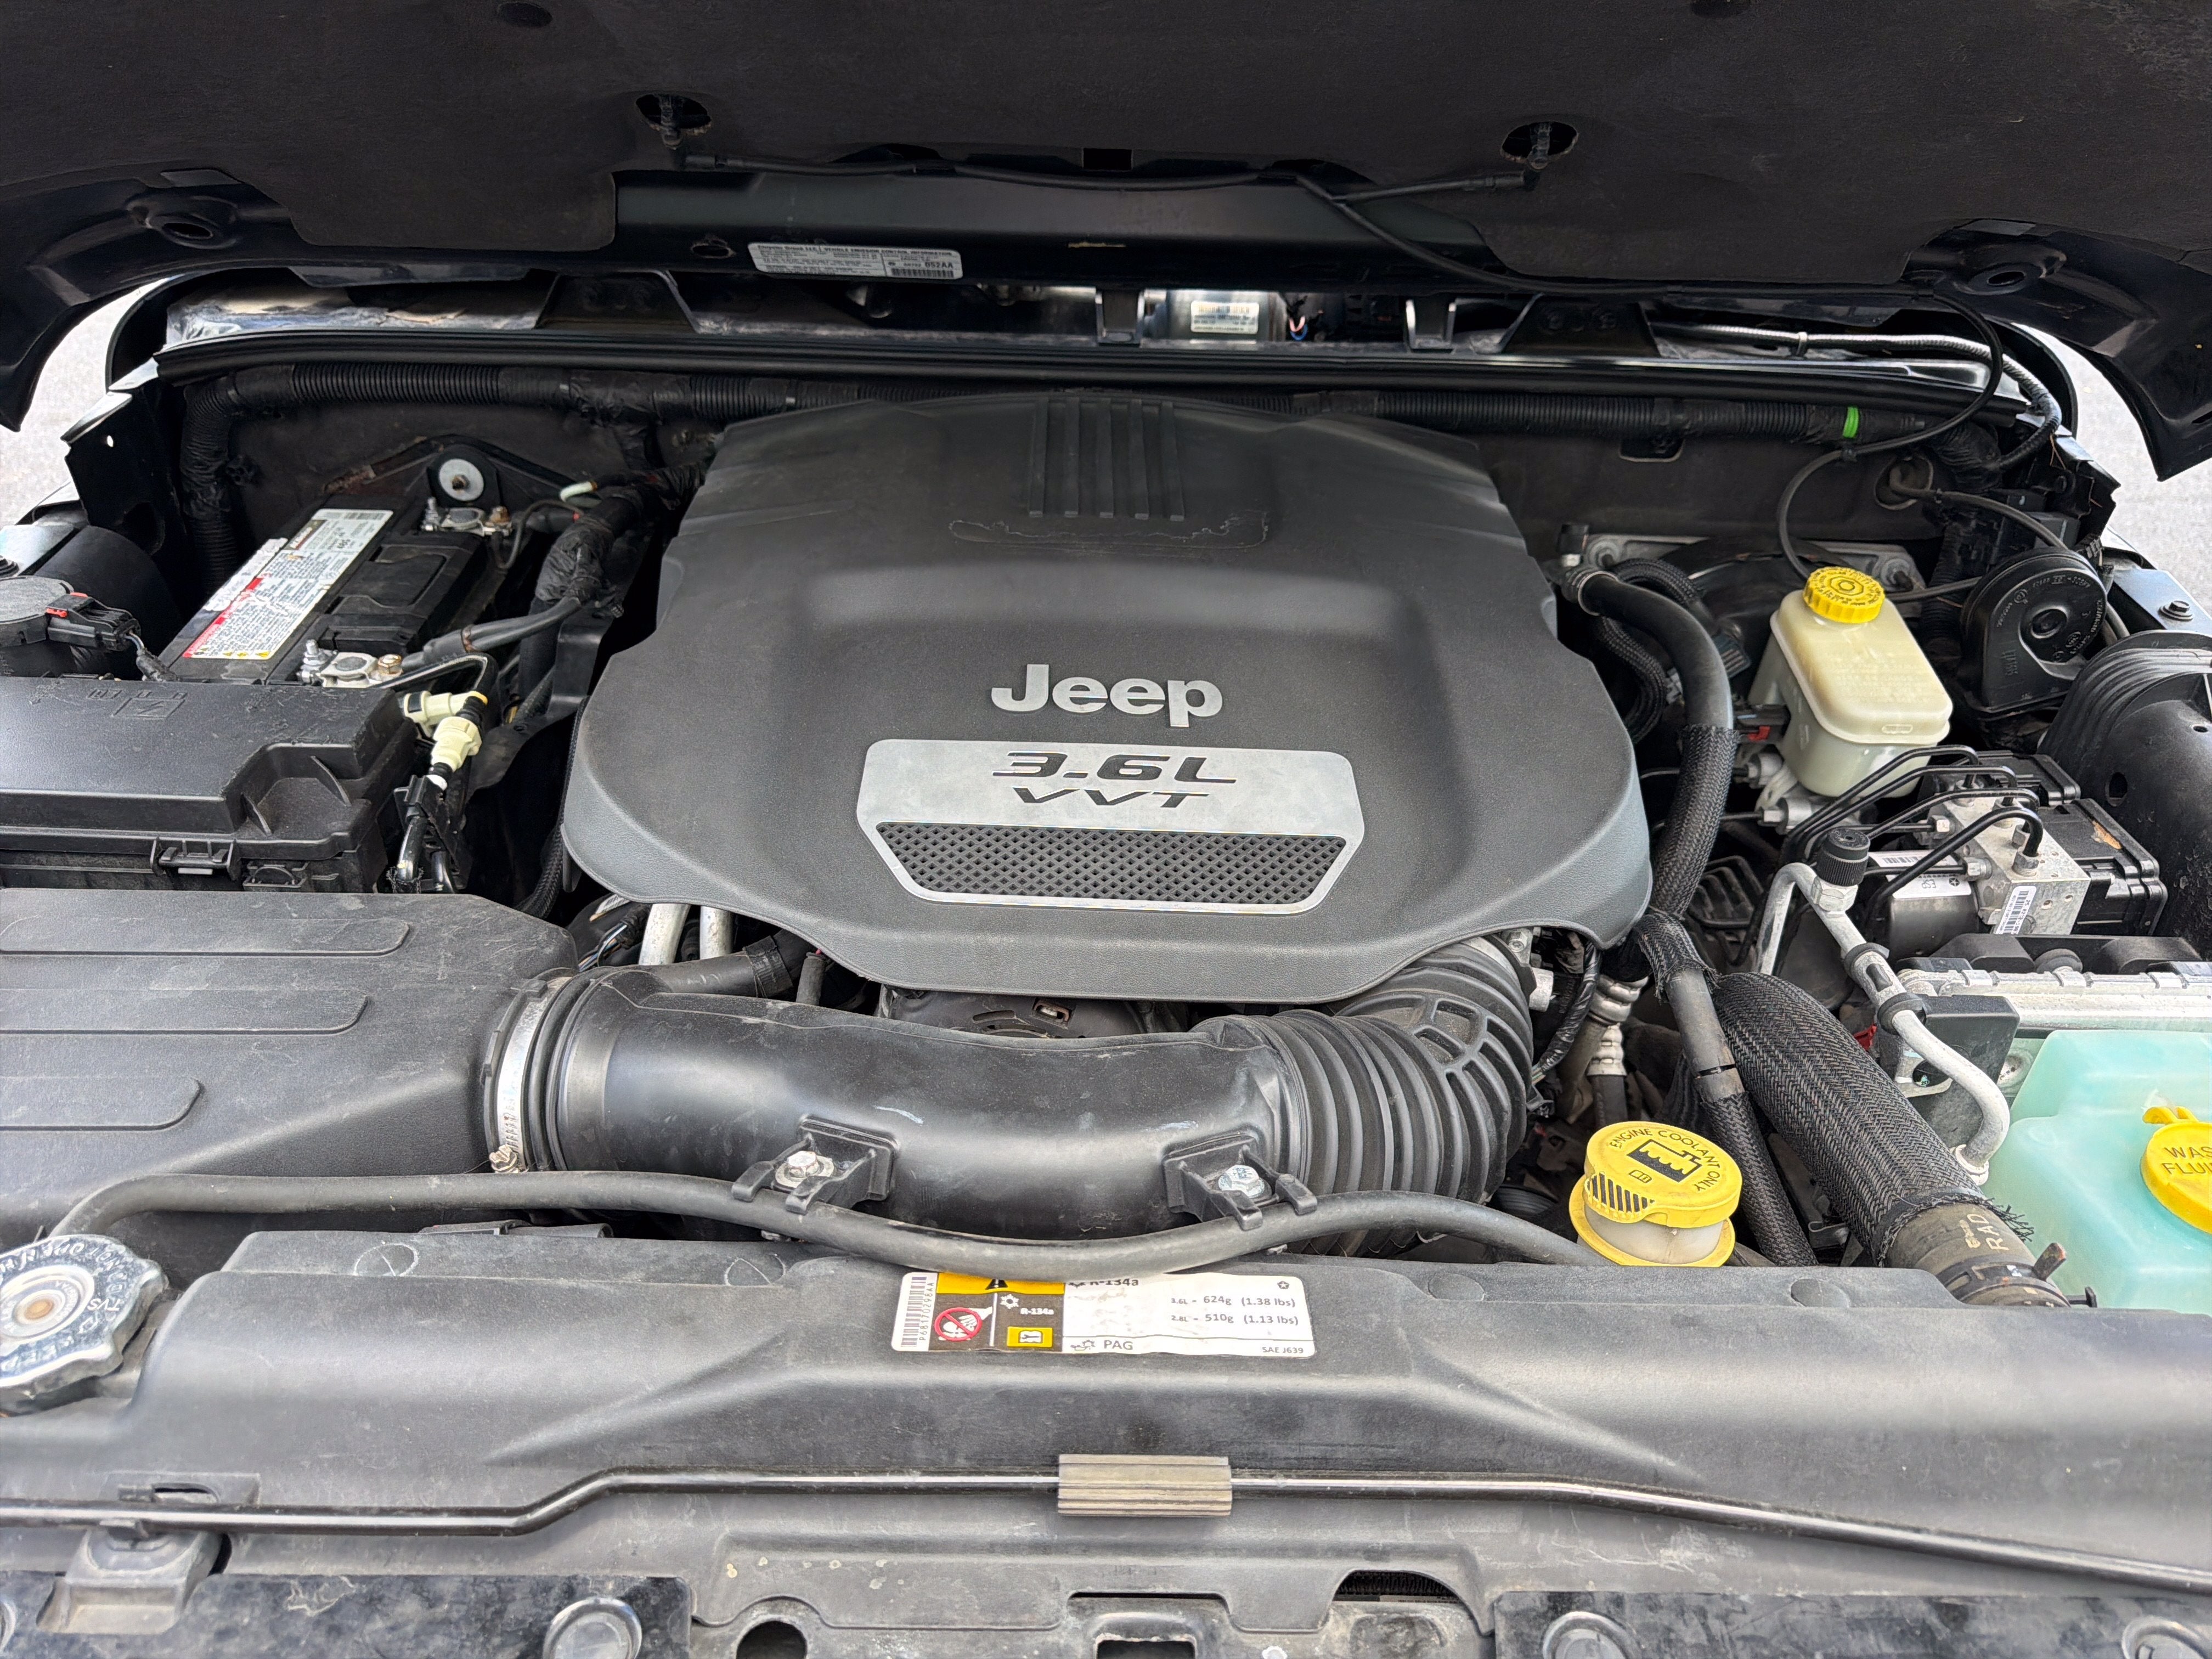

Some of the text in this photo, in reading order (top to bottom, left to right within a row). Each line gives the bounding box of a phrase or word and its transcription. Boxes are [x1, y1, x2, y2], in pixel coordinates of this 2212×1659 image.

[991, 664, 1223, 728] Jeep
[991, 750, 1237, 784] 3.6L
[1012, 786, 1210, 809] VVT
[1609, 1128, 1721, 1192] ENGINE COOLANT ONLY
[2161, 1162, 2212, 1175] FLUI
[1967, 1213, 2009, 1251] RAD
[87, 1297, 123, 1312] TVS
[1203, 1295, 1232, 1306] 624g
[1241, 1297, 1271, 1307] (1.38
[1274, 1297, 1296, 1308] lbs)
[918, 1282, 934, 1341] P68170298AA
[1020, 1307, 1054, 1316] R-134a
[1205, 1313, 1234, 1324] 510g
[1244, 1314, 1274, 1325] (1.13
[1277, 1315, 1299, 1326] lbs)
[1103, 1340, 1133, 1351] PAG
